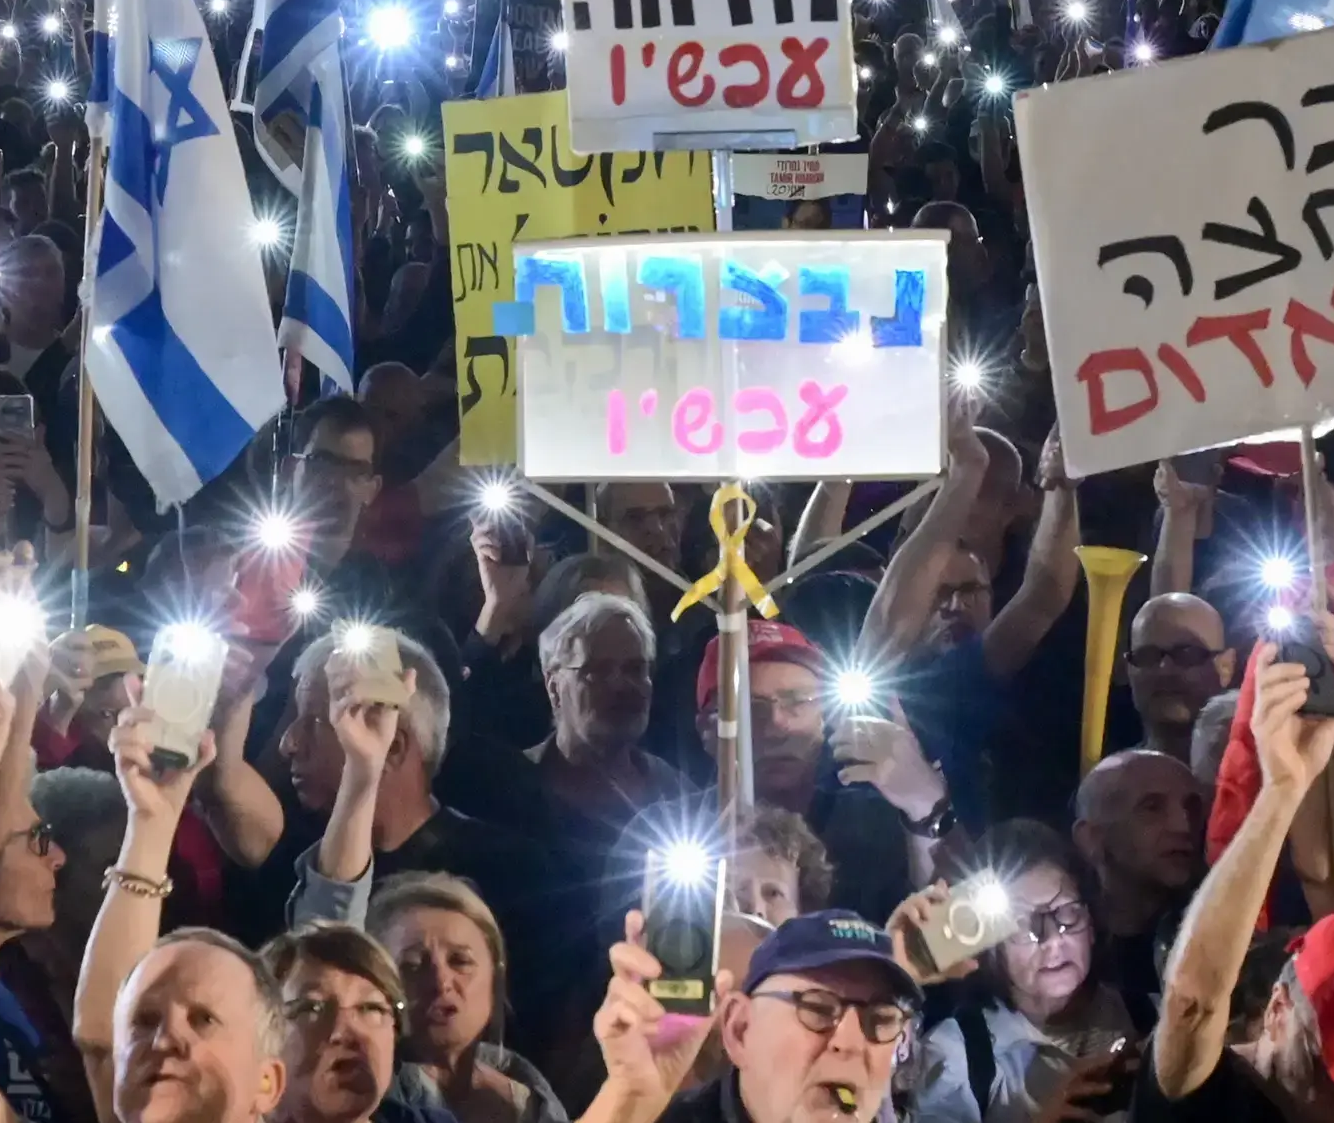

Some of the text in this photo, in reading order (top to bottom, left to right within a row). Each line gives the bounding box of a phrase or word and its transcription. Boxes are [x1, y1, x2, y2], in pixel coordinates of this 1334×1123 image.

[609, 36, 830, 110] עכשיו
[455, 239, 500, 302] את
[493, 250, 924, 348] נבצרות
[606, 379, 848, 459] עכשיו
